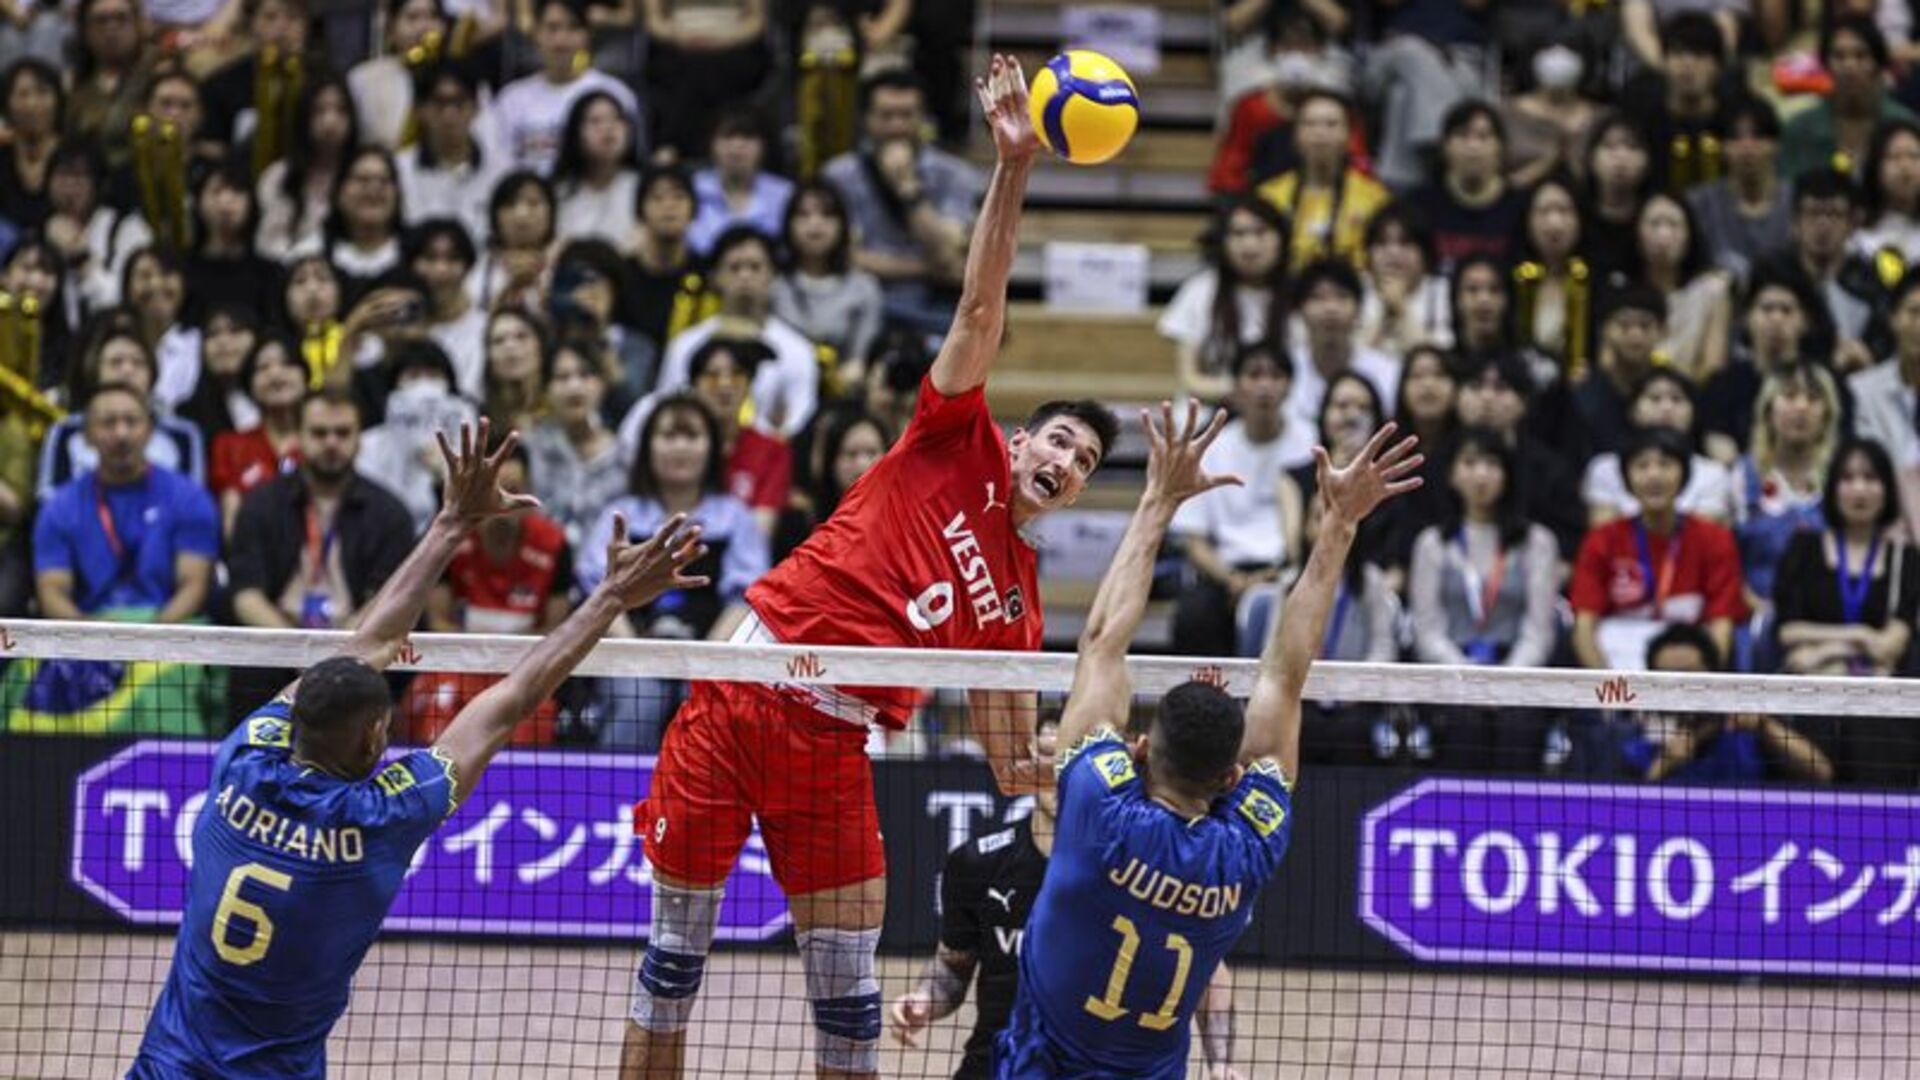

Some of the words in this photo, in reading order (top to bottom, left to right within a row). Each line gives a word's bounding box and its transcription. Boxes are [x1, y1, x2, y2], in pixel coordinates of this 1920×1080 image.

[942, 510, 1004, 631] VESTEL
[786, 650, 827, 678] VNL
[1594, 674, 1637, 704] VNL
[215, 784, 364, 863] ADRIANO
[654, 817, 667, 844] 9
[1109, 857, 1242, 919] JUDSON
[1388, 827, 1715, 920] TOKIO
[211, 862, 293, 966] 6
[1083, 914, 1194, 1030] 11
